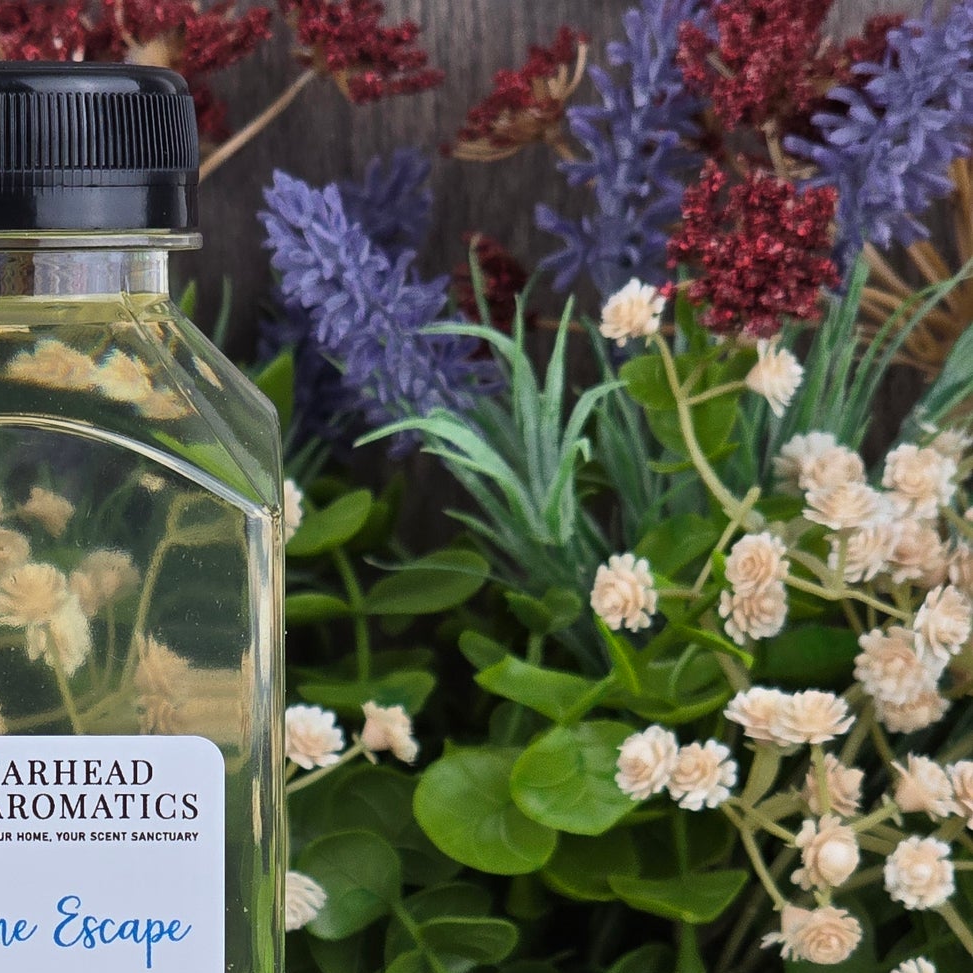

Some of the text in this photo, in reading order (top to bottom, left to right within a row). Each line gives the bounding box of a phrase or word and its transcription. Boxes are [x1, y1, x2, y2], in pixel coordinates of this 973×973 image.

[16, 831, 53, 843] HOME,
[55, 831, 86, 842] YOUR
[90, 831, 128, 842] SCENT
[130, 831, 199, 842] SANCTUARY
[52, 894, 193, 970] Escape
